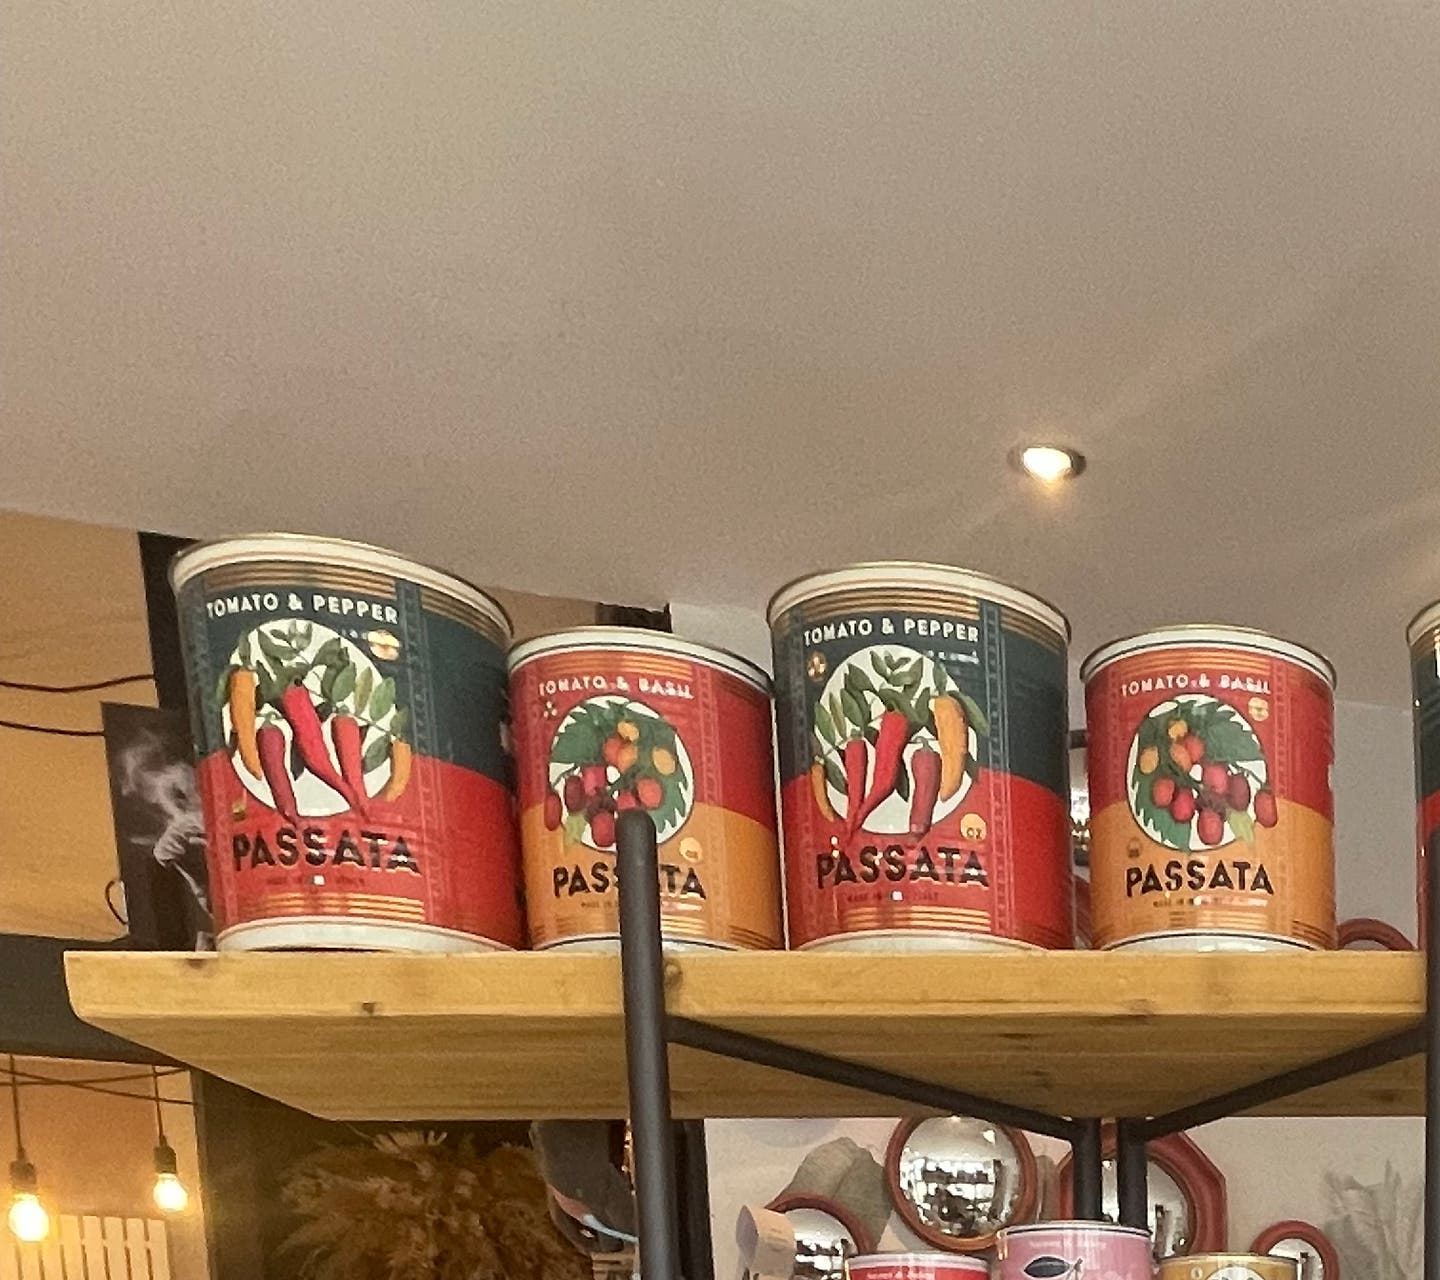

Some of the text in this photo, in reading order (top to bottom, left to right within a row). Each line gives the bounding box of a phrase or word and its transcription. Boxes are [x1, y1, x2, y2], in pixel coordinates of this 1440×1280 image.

[207, 593, 399, 625] TOMATO & PEPPER
[804, 617, 980, 645] TOMATO & PEPPER
[539, 676, 606, 697] TOMATO
[637, 678, 695, 700] BASIL
[1121, 675, 1190, 698] TOMATO
[1220, 674, 1272, 695] BASIL
[232, 827, 423, 876] PASSATA
[816, 844, 989, 890] PASSATA
[552, 861, 707, 900] PASTA
[1126, 859, 1275, 898] PASSATA
